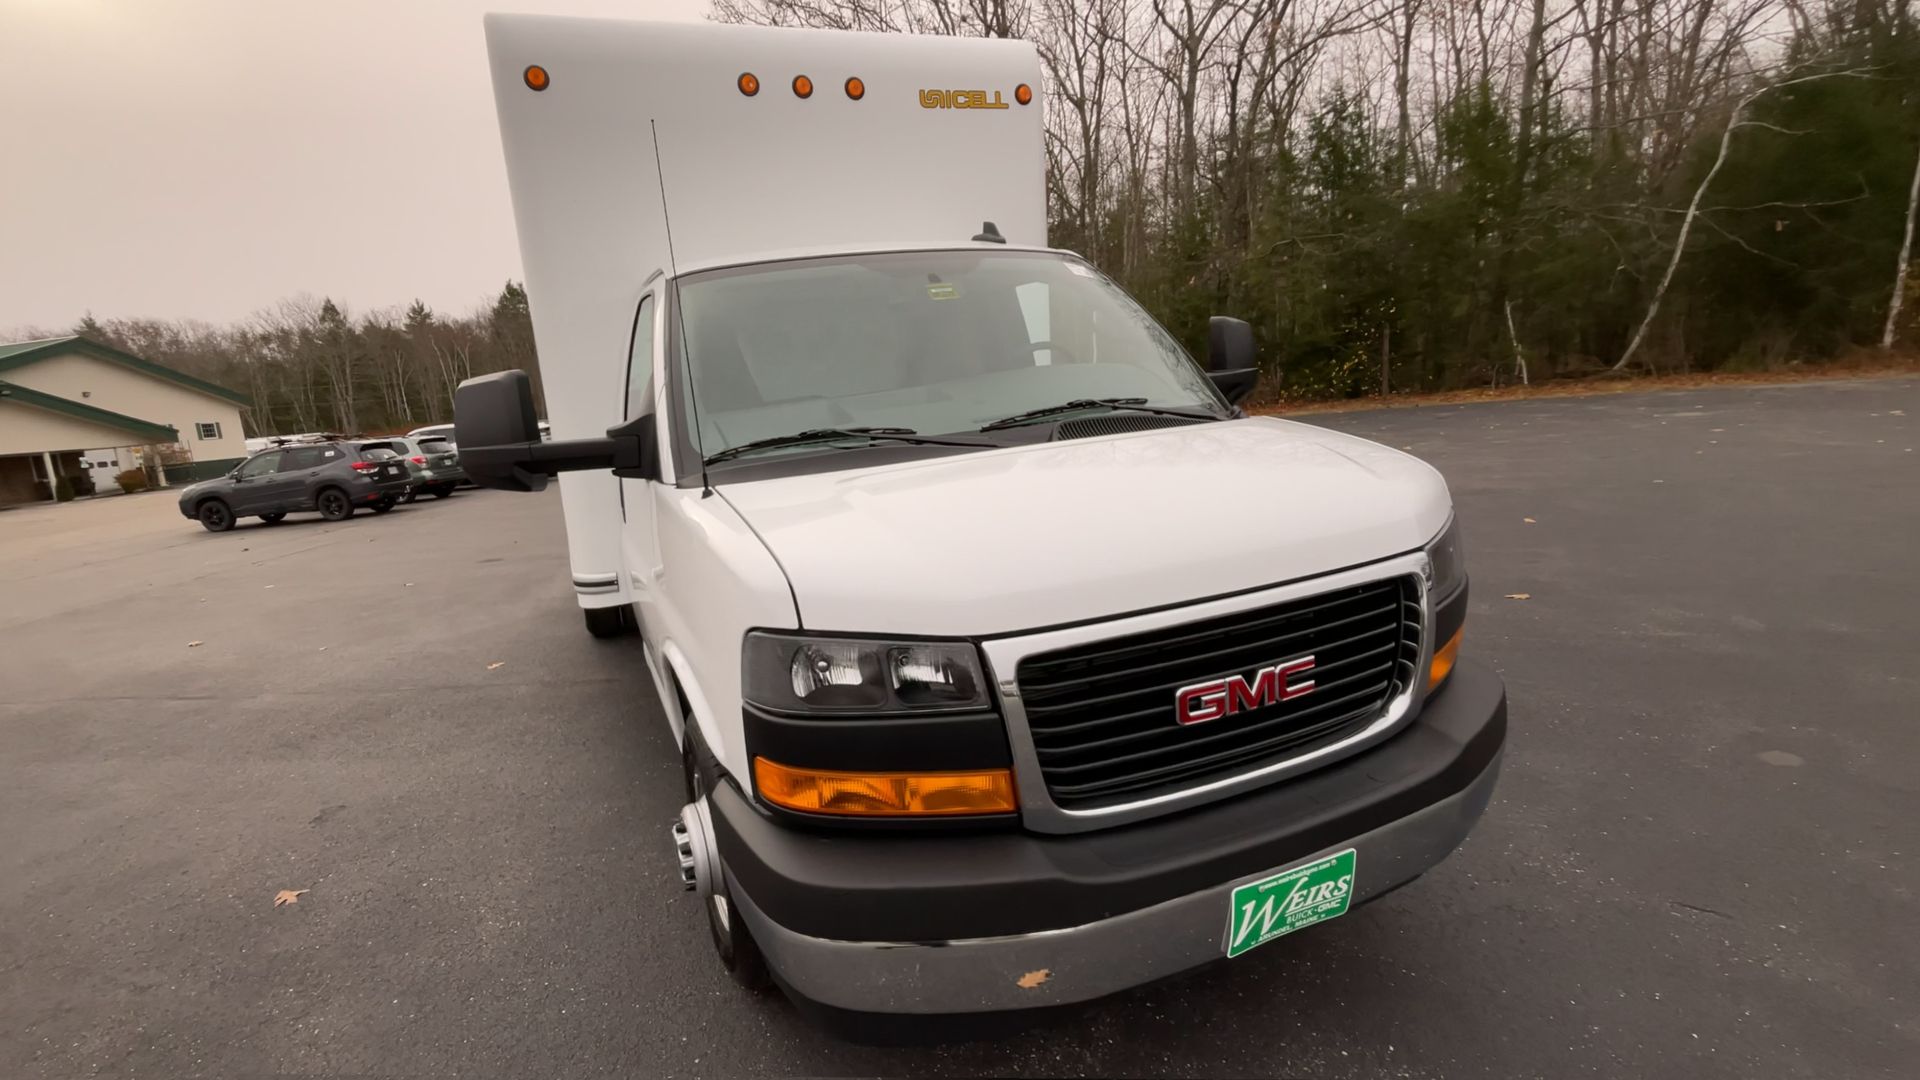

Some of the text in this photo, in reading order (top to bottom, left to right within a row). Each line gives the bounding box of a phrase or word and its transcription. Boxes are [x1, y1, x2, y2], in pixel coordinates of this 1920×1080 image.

[919, 89, 1009, 109] UNICELL
[1175, 655, 1316, 725] GMC
[1233, 874, 1351, 947] WEIRS
[1286, 899, 1342, 924] BUICK GMC
